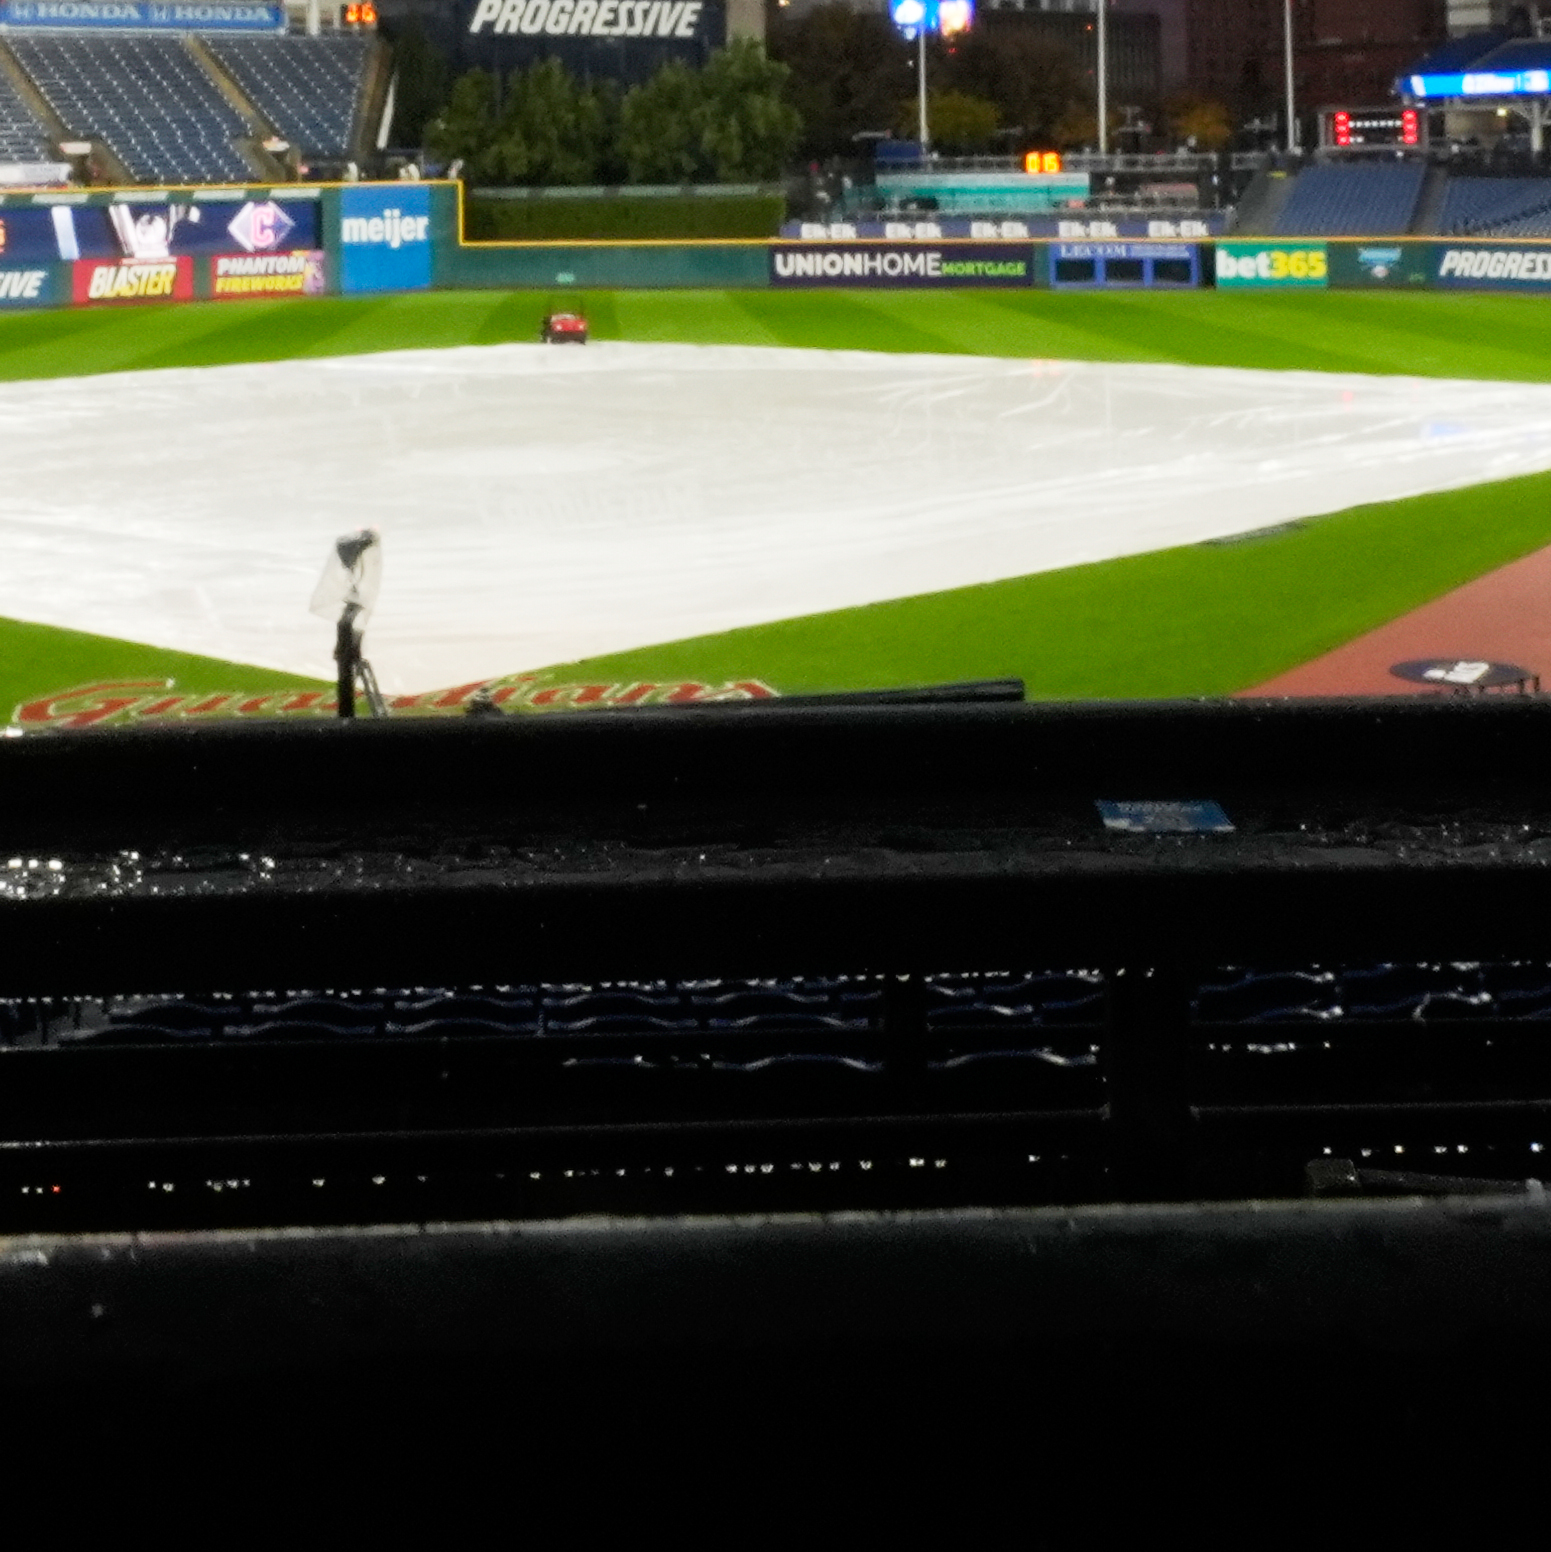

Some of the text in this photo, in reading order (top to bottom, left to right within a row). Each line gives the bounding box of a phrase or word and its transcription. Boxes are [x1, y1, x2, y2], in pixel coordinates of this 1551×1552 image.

[173, 2, 271, 24] HONDA
[342, 207, 430, 250] meijer
[217, 257, 305, 276] PHANTOM
[942, 261, 1027, 277] MORTGAGE
[1216, 248, 1328, 279] bet365
[88, 263, 178, 299] BLASTER
[215, 274, 304, 294] FIREWORKS
